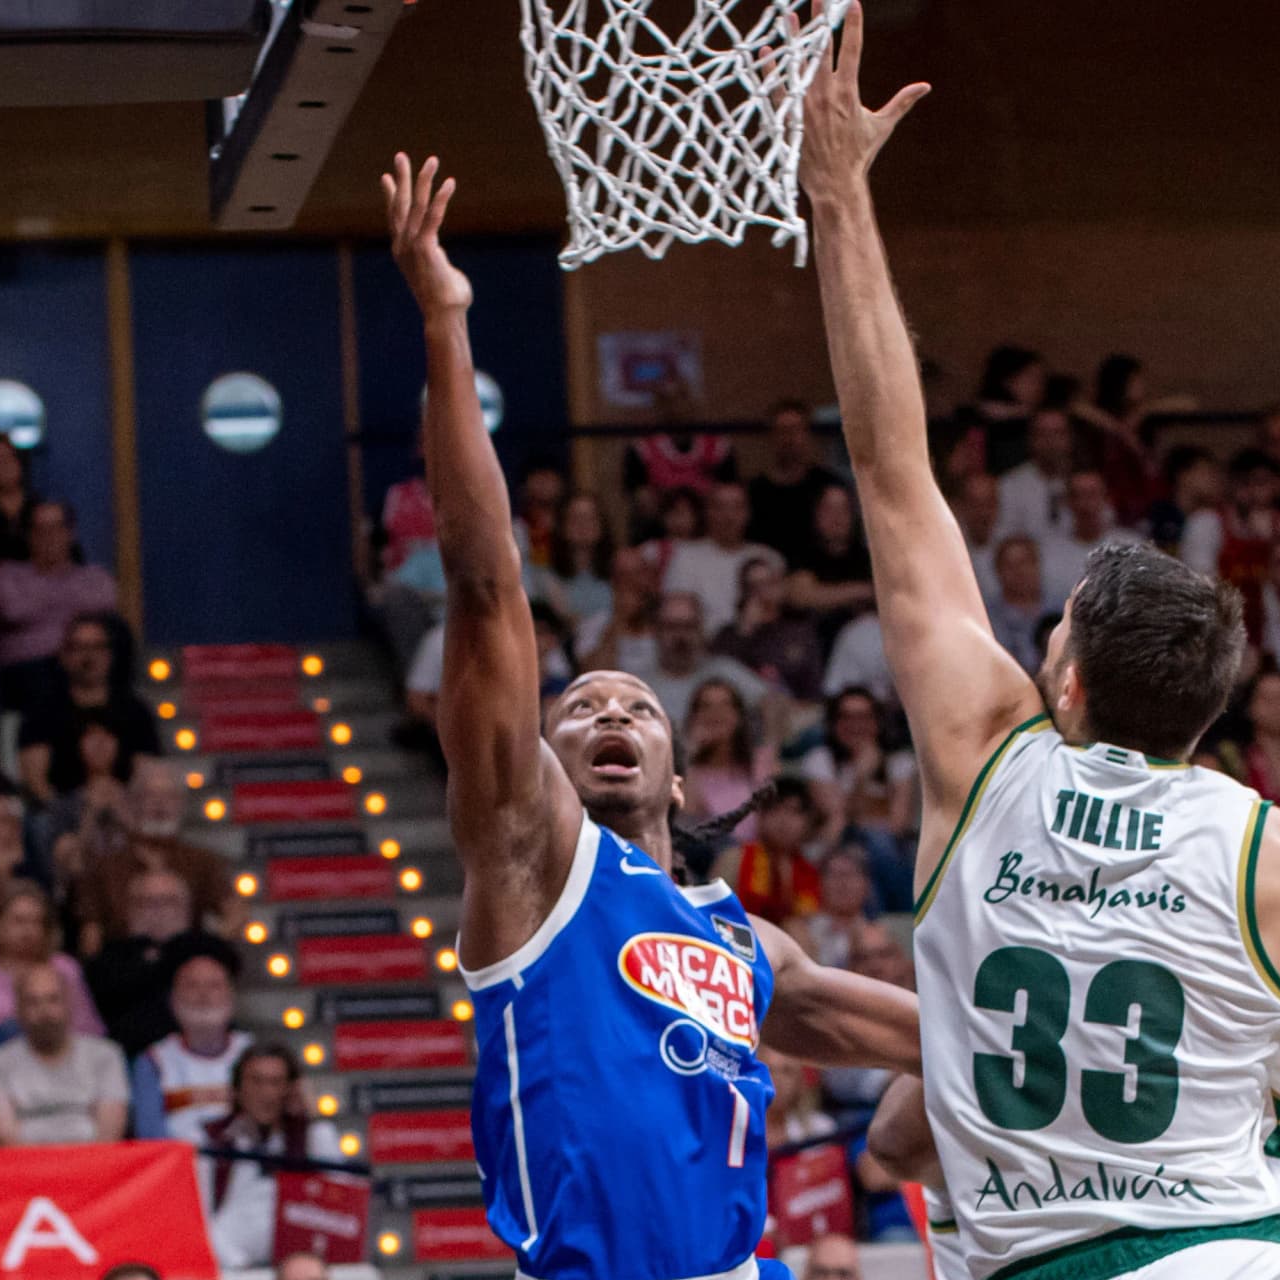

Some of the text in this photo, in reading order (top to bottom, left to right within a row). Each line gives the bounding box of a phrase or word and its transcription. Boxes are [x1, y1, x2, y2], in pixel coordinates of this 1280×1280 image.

[1050, 788, 1164, 851] TILLIE
[972, 945, 1185, 1145] 33
[728, 1081, 751, 1168] 1
[974, 1155, 1215, 1212] Andalucía
